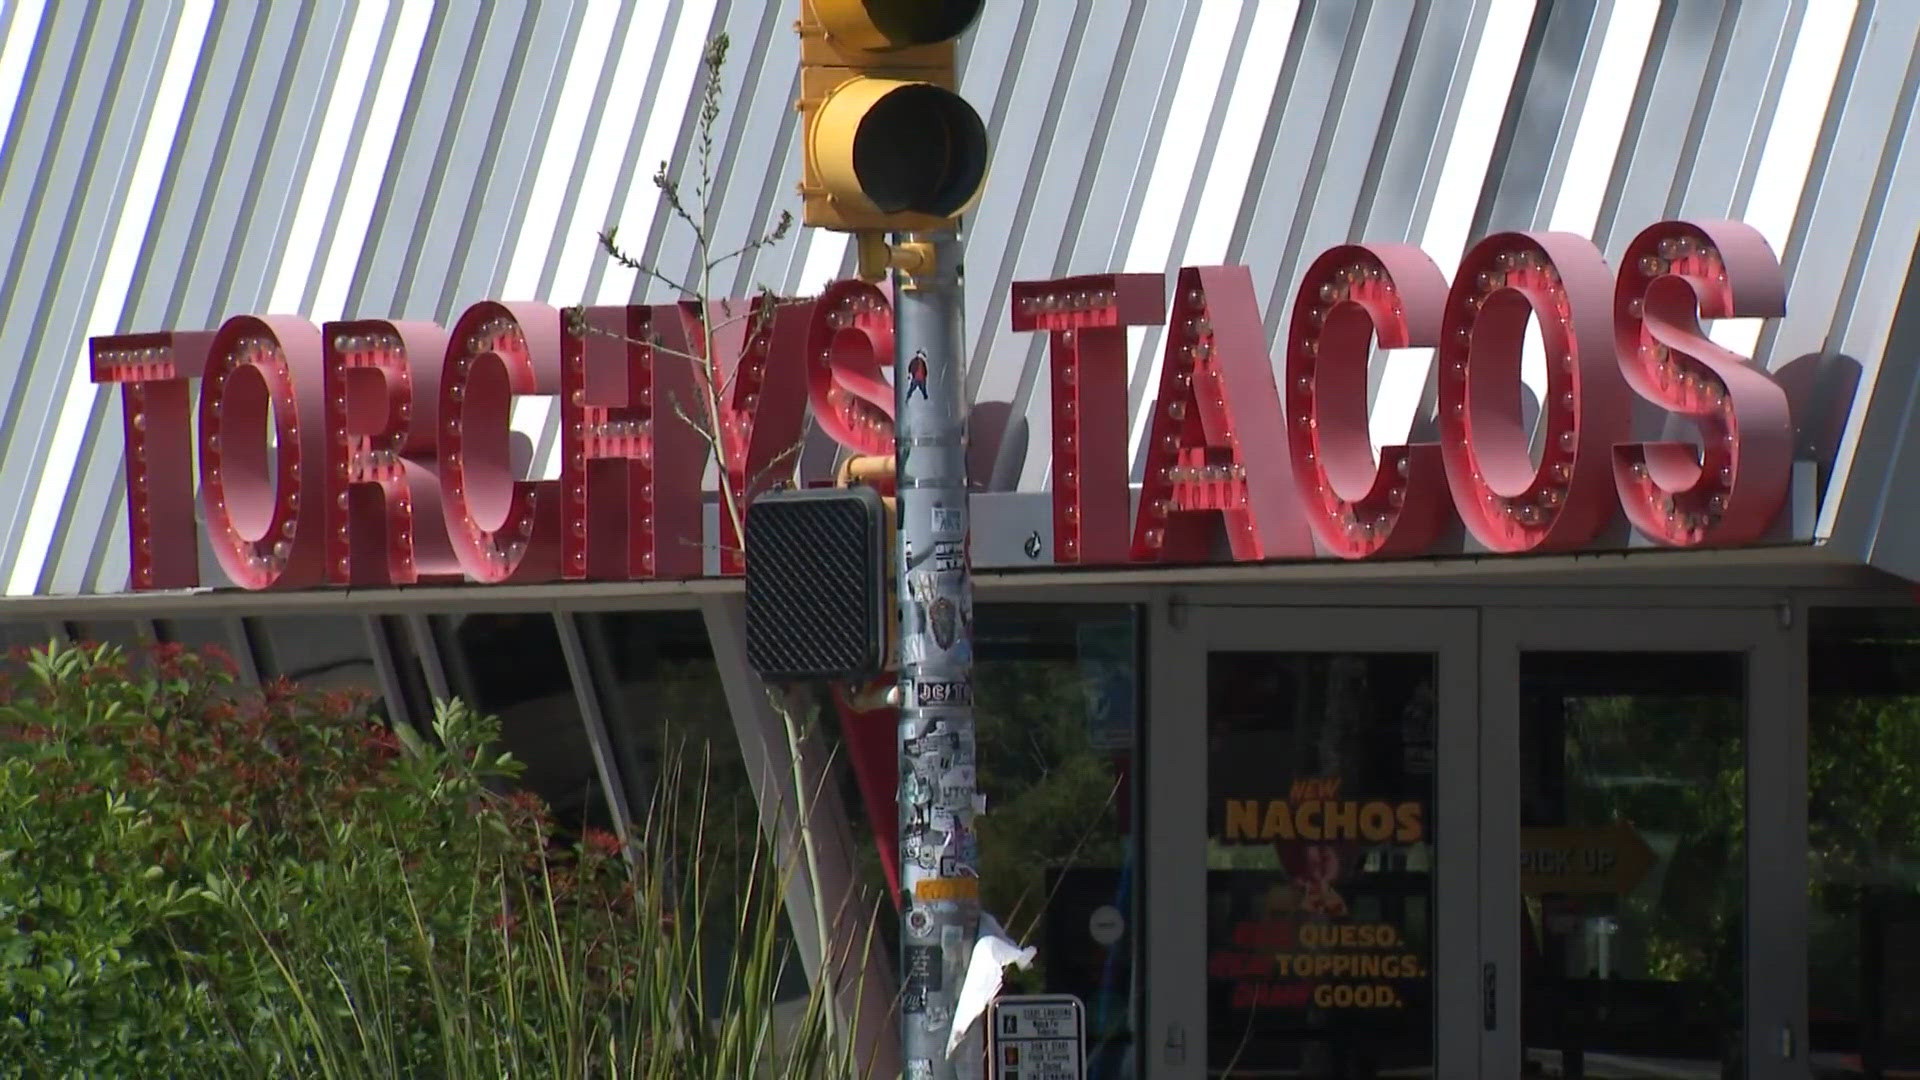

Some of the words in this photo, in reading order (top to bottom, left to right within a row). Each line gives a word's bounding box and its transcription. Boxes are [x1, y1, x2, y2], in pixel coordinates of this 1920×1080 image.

[1011, 220, 1791, 564] TACOS
[1289, 777, 1342, 801] NEW
[1225, 799, 1423, 842] NACHOS
[1584, 846, 1616, 873] UP
[1299, 922, 1405, 949] QUESO.
[1276, 954, 1426, 979] TOPPINGS.
[1314, 983, 1402, 1009] GOOD.
